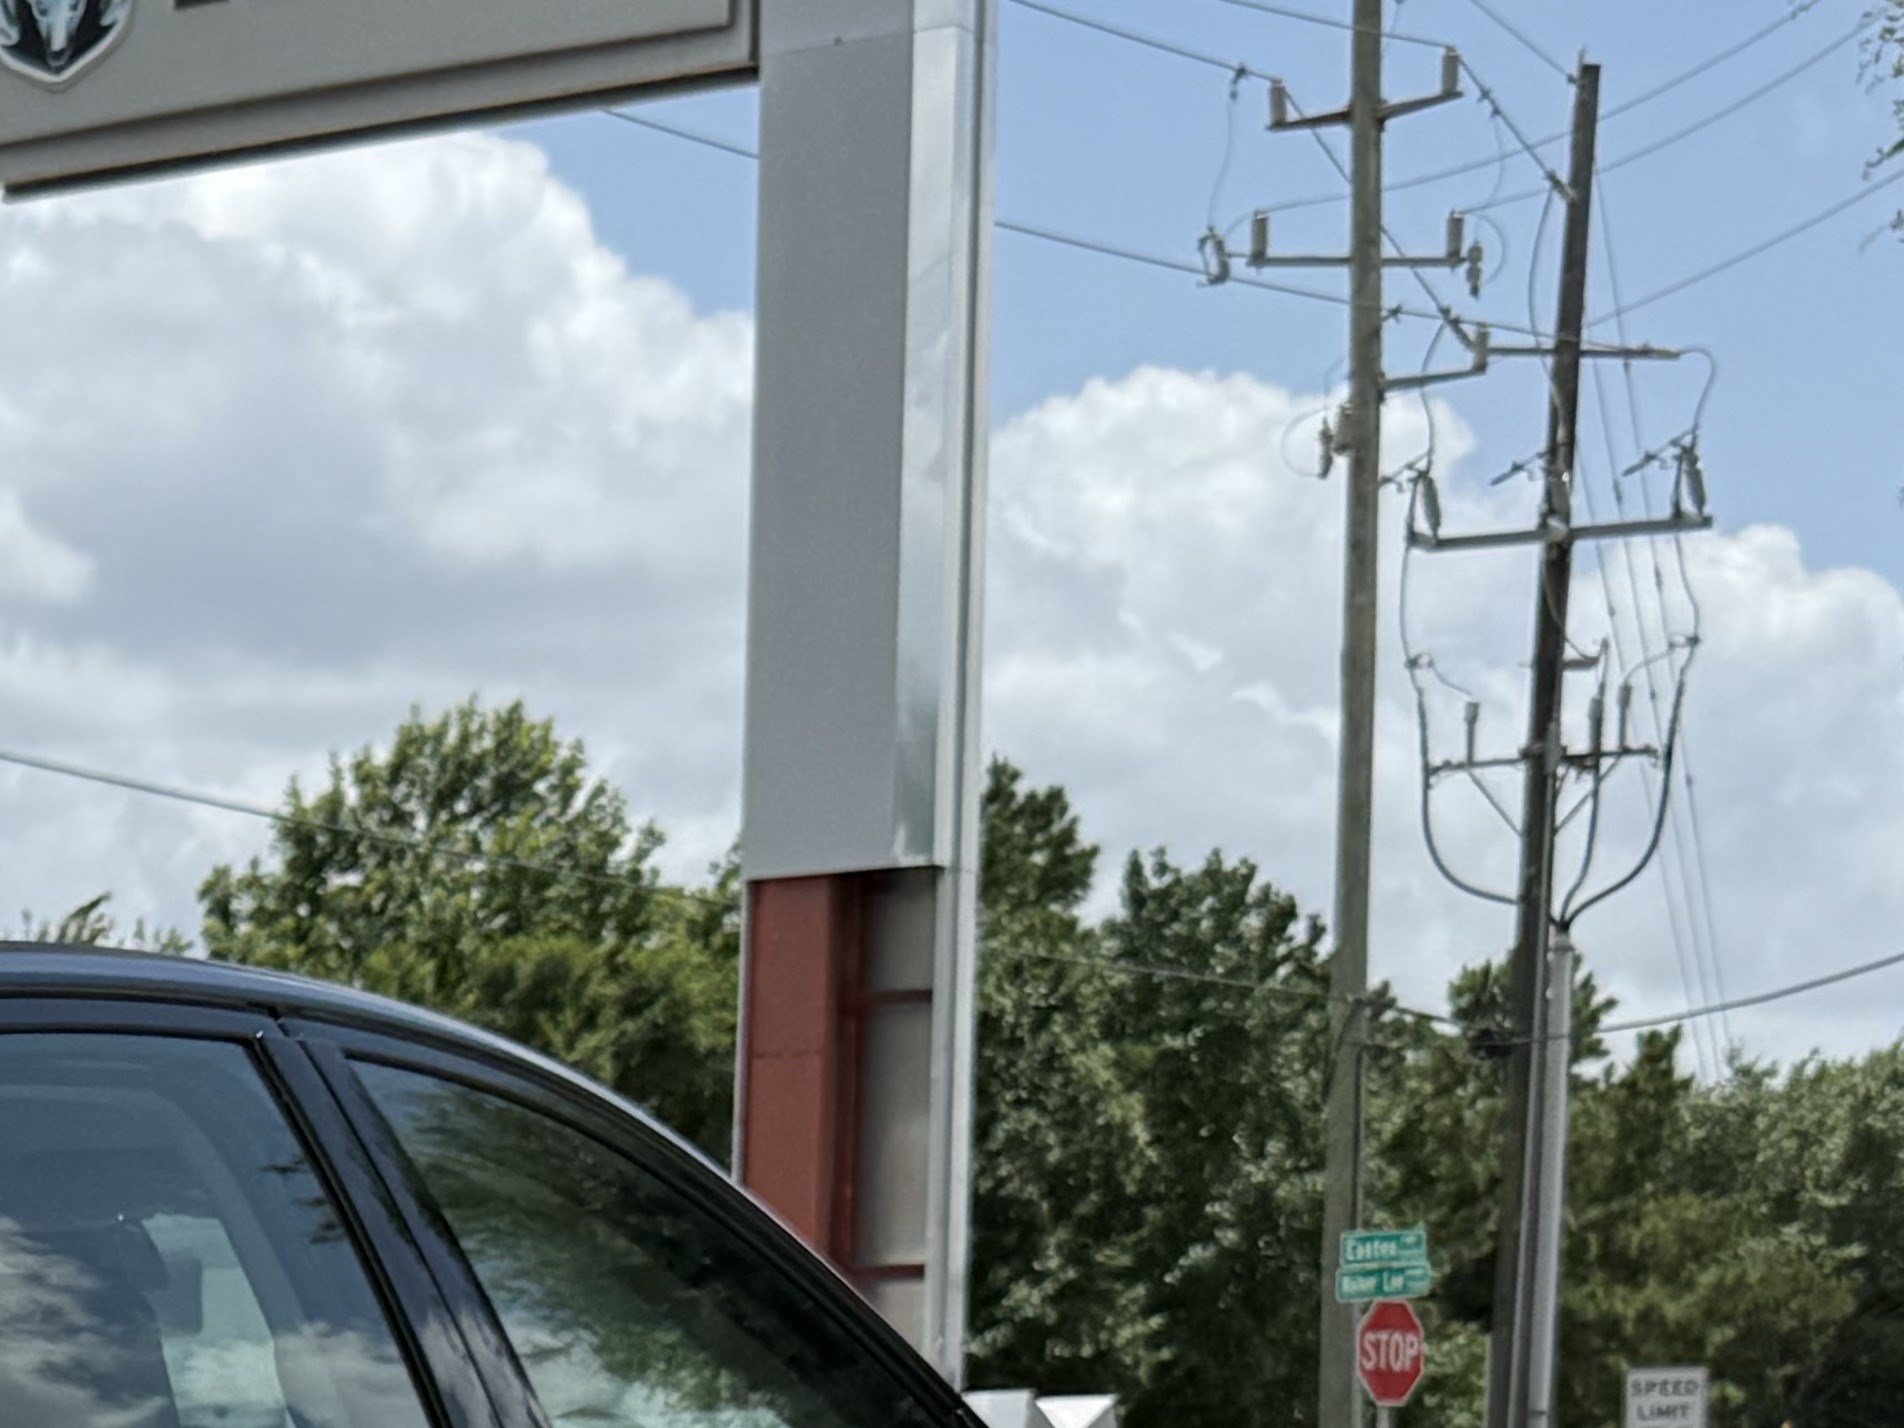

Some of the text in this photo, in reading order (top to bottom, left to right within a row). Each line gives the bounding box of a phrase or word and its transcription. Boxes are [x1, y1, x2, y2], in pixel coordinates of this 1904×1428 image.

[1361, 1330, 1418, 1371] STOP
[1632, 1379, 1698, 1396] SPEED
[1636, 1404, 1689, 1420] LIMIT
